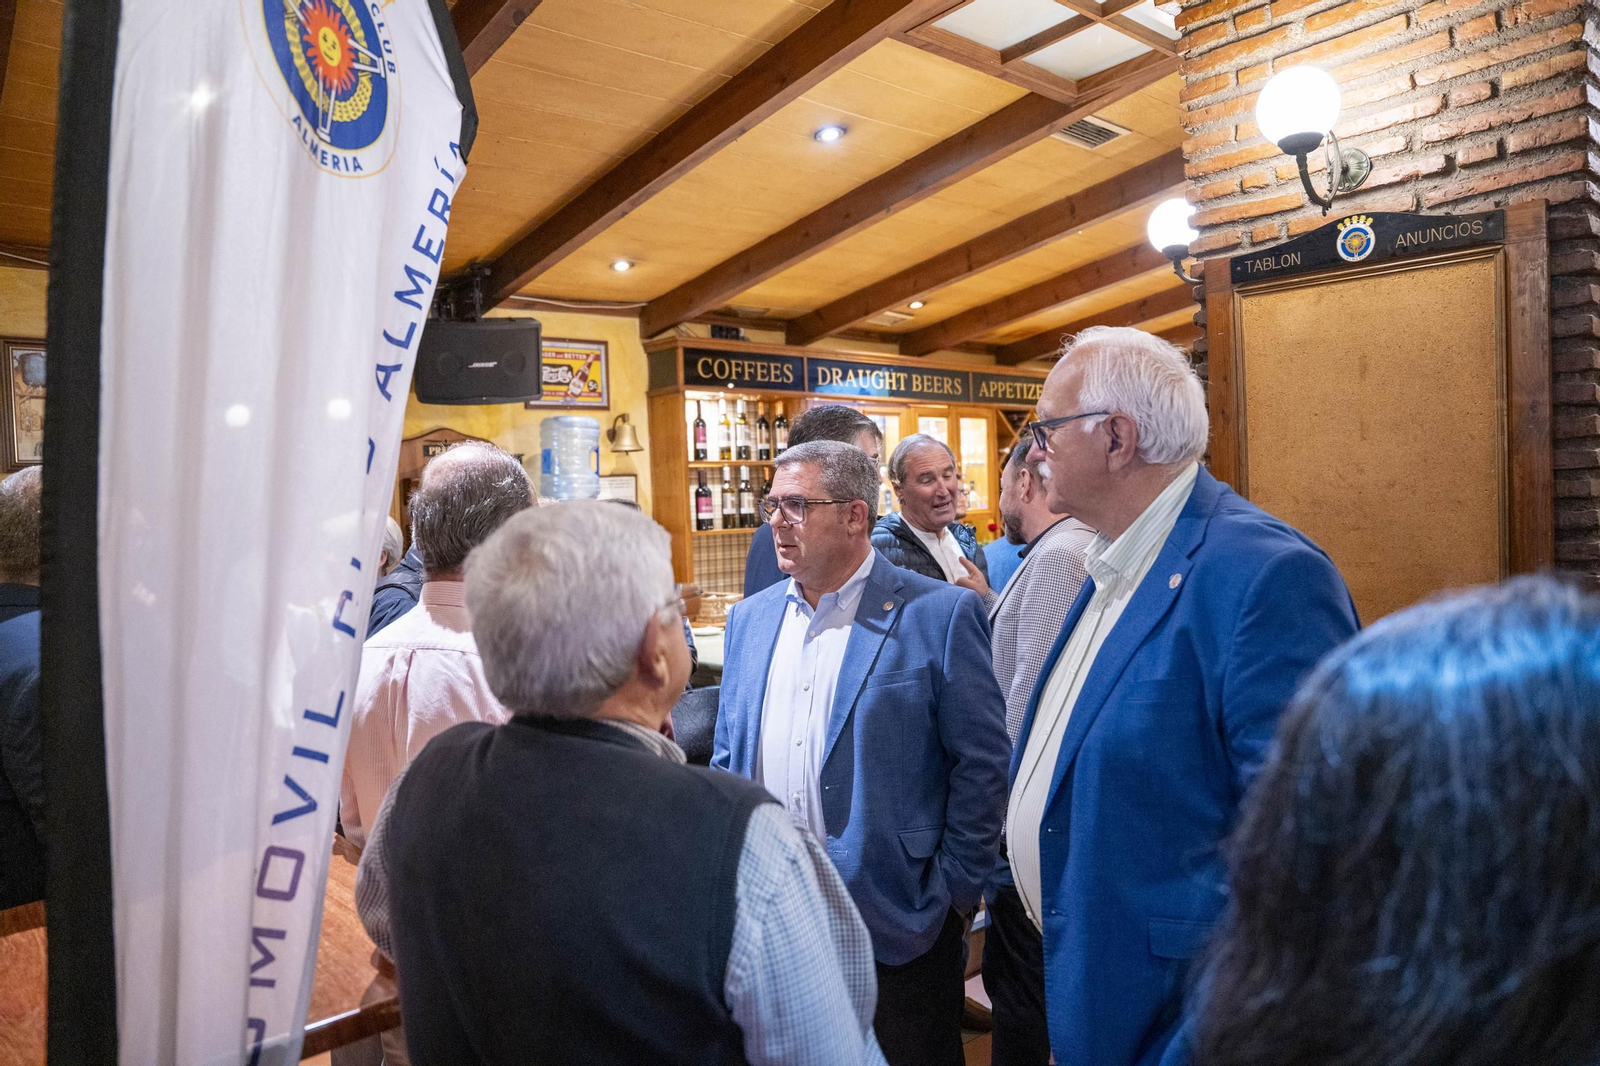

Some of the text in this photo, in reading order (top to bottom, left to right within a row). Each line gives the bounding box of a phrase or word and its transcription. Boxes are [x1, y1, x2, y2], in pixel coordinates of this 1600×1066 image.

[371, 2, 396, 74] CLUB
[292, 115, 364, 173] ALMERIA
[1245, 219, 1484, 275] TABLON ANUNCIOS
[696, 357, 794, 384] COFFEES
[816, 365, 963, 396] DRAUGHT BEERS
